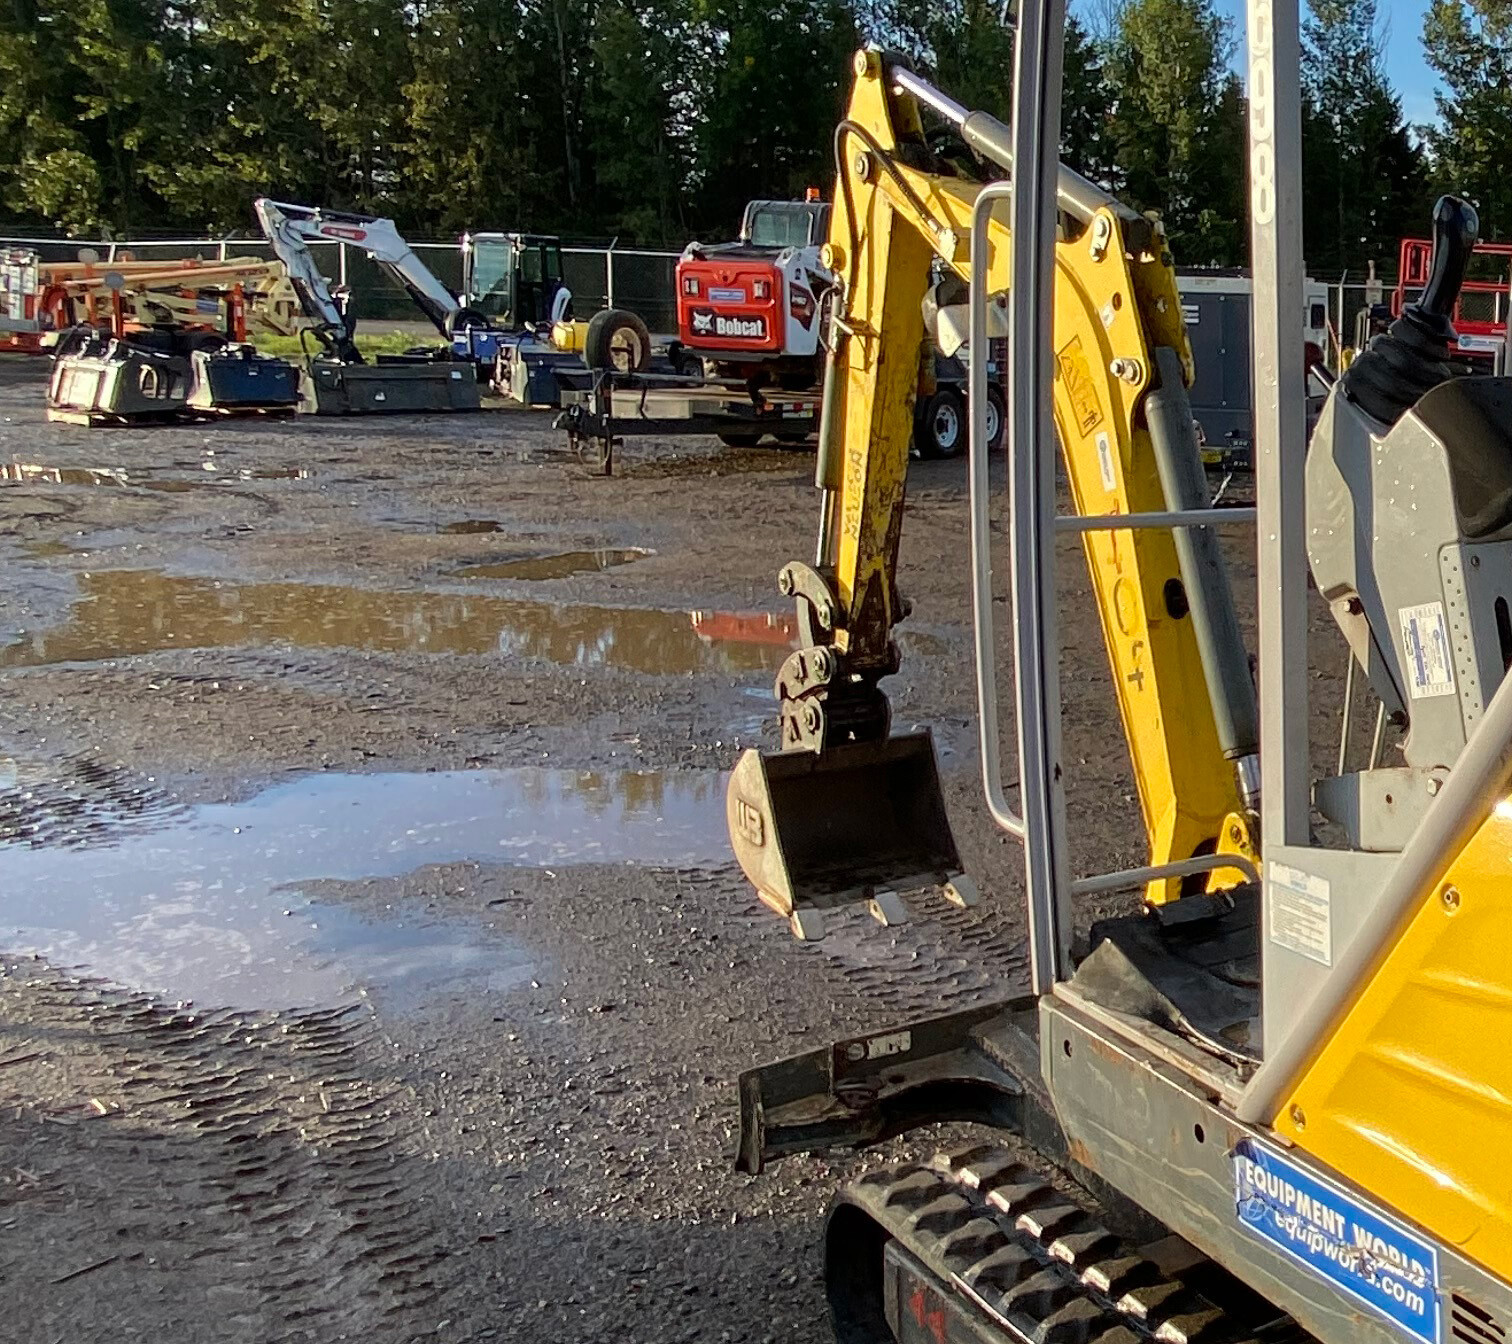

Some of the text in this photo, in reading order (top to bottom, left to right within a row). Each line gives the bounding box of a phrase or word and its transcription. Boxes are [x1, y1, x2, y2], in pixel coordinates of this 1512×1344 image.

[716, 317, 763, 337] Bobcat
[1245, 1158, 1427, 1289] EQUIPMENT WORLD
[1274, 1210, 1425, 1317] equipwor.com
